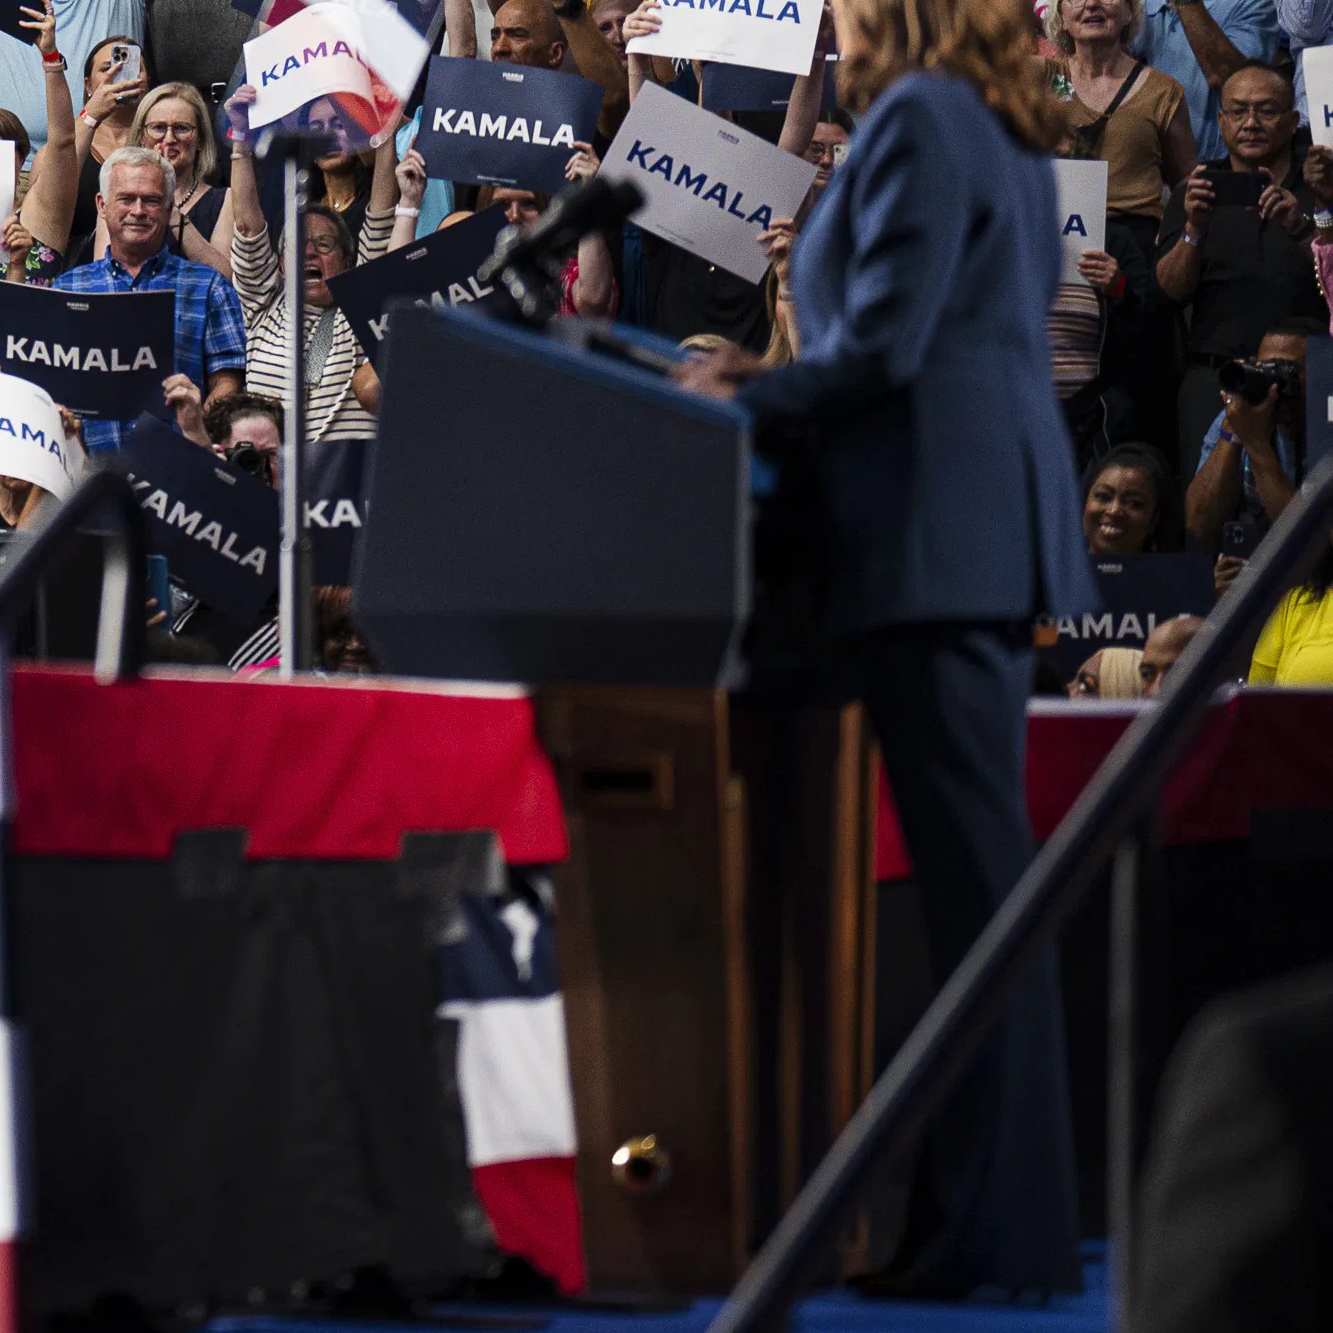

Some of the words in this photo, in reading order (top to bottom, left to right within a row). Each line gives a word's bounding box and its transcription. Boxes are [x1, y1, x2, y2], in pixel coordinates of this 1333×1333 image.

[433, 108, 573, 148] KAMALA
[627, 140, 772, 231] KAMALA
[5, 336, 157, 372] KAMALA
